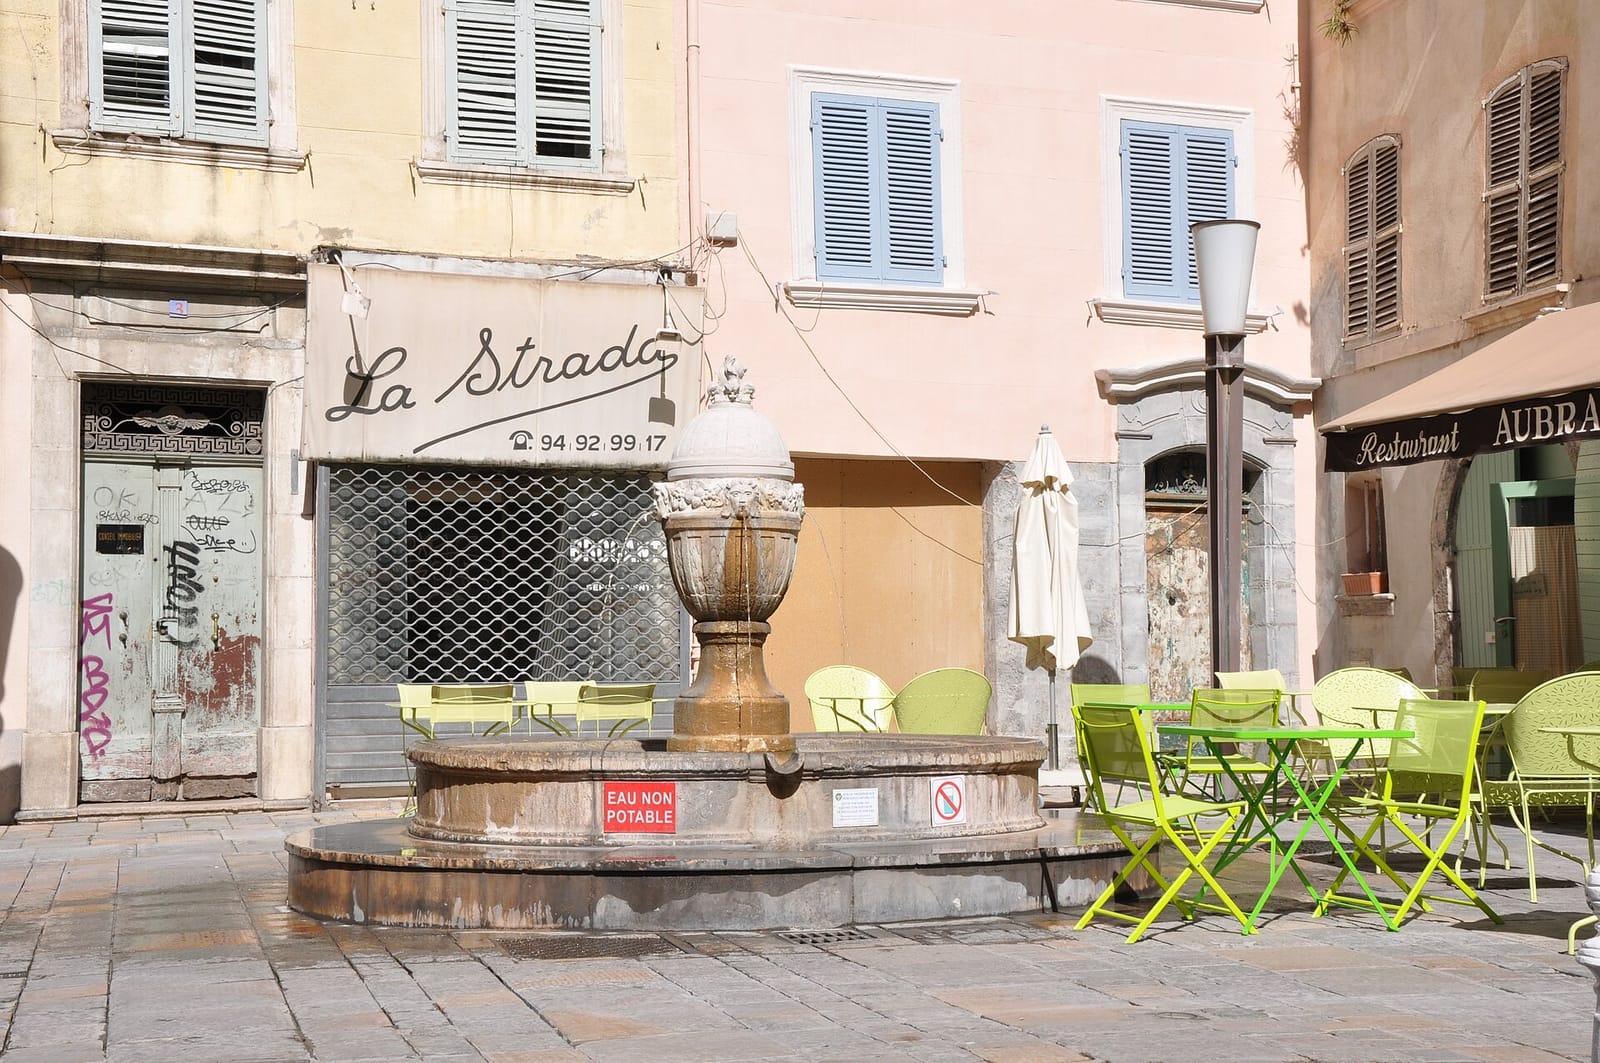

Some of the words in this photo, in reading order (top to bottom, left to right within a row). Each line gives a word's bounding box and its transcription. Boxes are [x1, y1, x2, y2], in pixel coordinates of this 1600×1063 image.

[326, 346, 416, 422] La
[435, 323, 679, 403] Strada
[541, 434, 566, 451] 94
[575, 434, 601, 451] 92
[610, 434, 636, 451] 99
[645, 434, 667, 452] 17
[1356, 422, 1460, 465] Restaurant
[607, 791, 637, 805] EAU
[642, 791, 673, 805] NON
[607, 809, 673, 824] POTABLE
